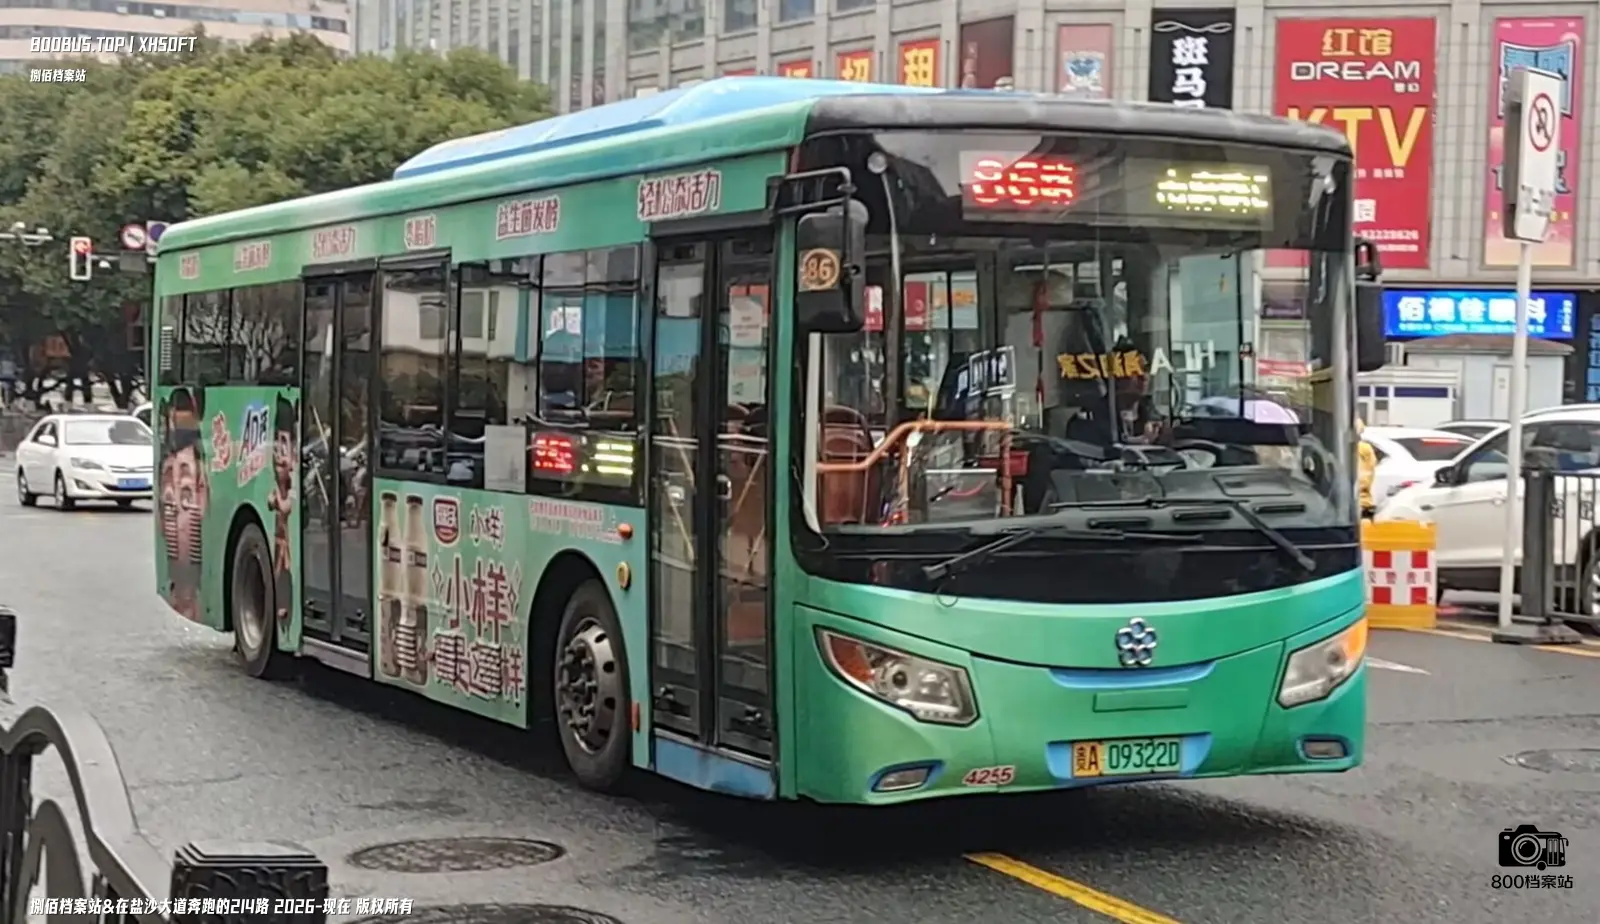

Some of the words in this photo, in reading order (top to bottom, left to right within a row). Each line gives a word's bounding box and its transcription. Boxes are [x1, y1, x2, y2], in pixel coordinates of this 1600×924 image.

[1321, 28, 1393, 57] 红馆
[1171, 35, 1209, 109] 斑马
[1291, 60, 1420, 81] DREAM
[807, 260, 833, 281] 86
[446, 556, 508, 643] 小样
[1107, 740, 1180, 770] 09322D
[964, 767, 1013, 786] 4255
